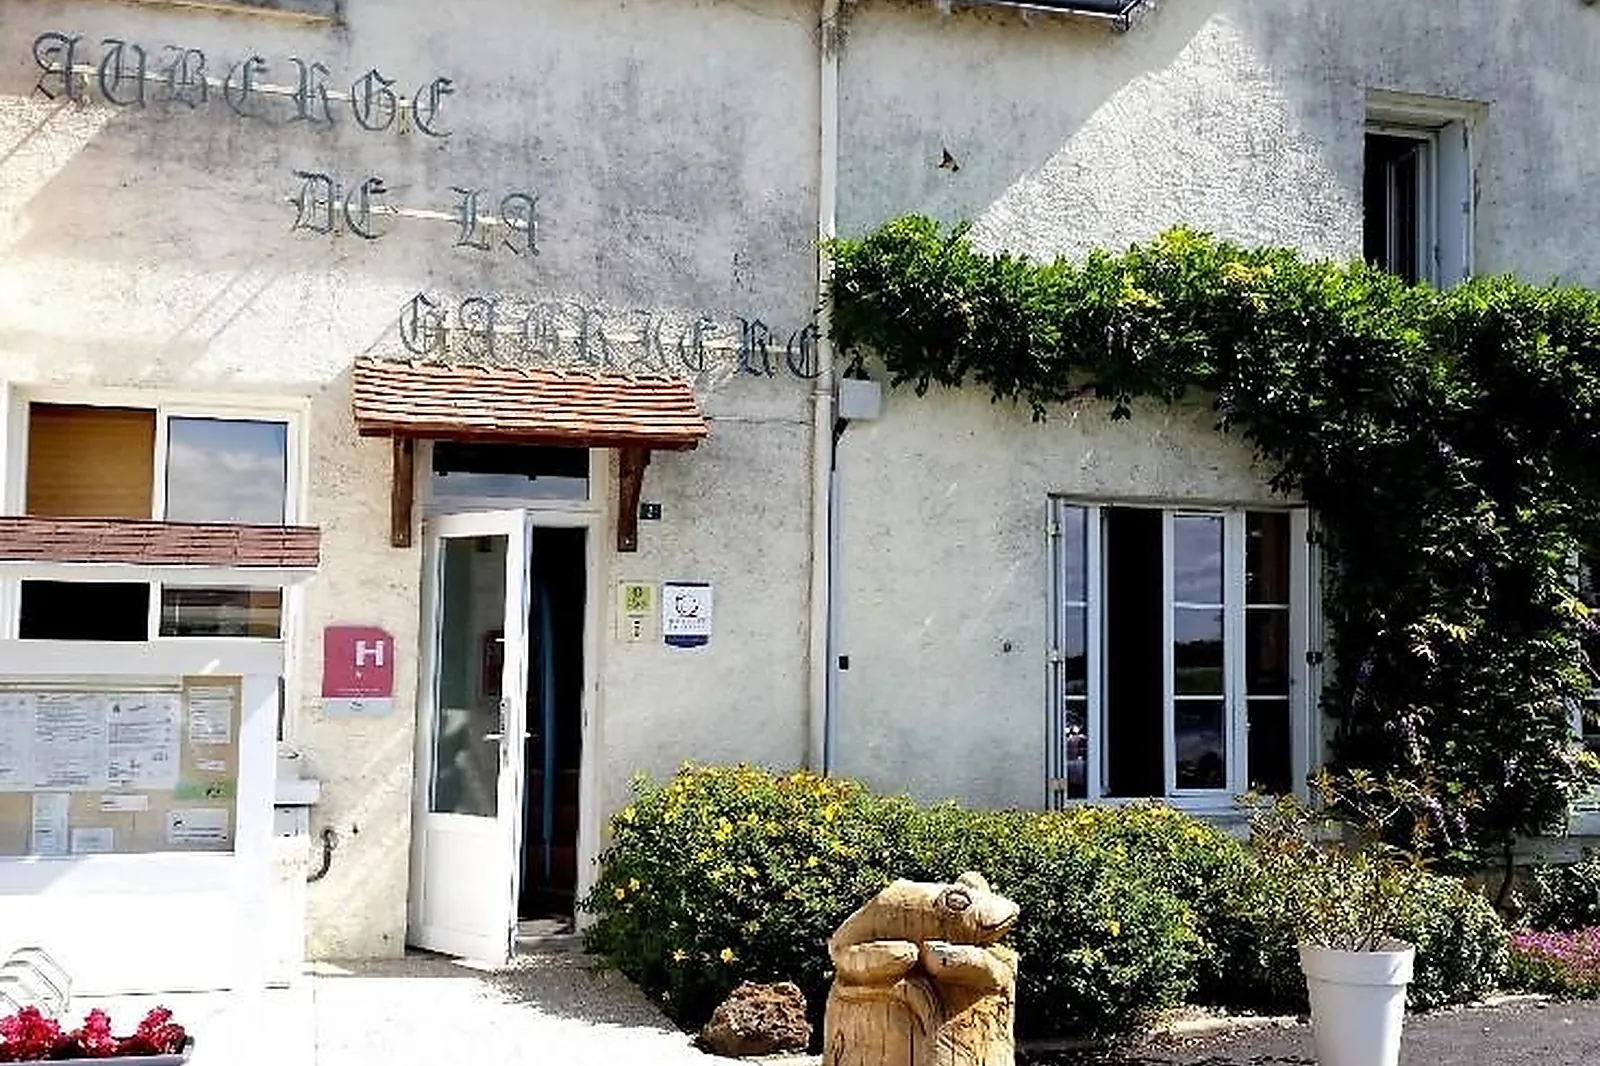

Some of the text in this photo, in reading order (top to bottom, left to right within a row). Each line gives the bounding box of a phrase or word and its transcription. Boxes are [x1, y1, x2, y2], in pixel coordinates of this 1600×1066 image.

[33, 32, 453, 137] AUBERGE
[291, 170, 540, 257] DE LA
[355, 640, 384, 666] H
